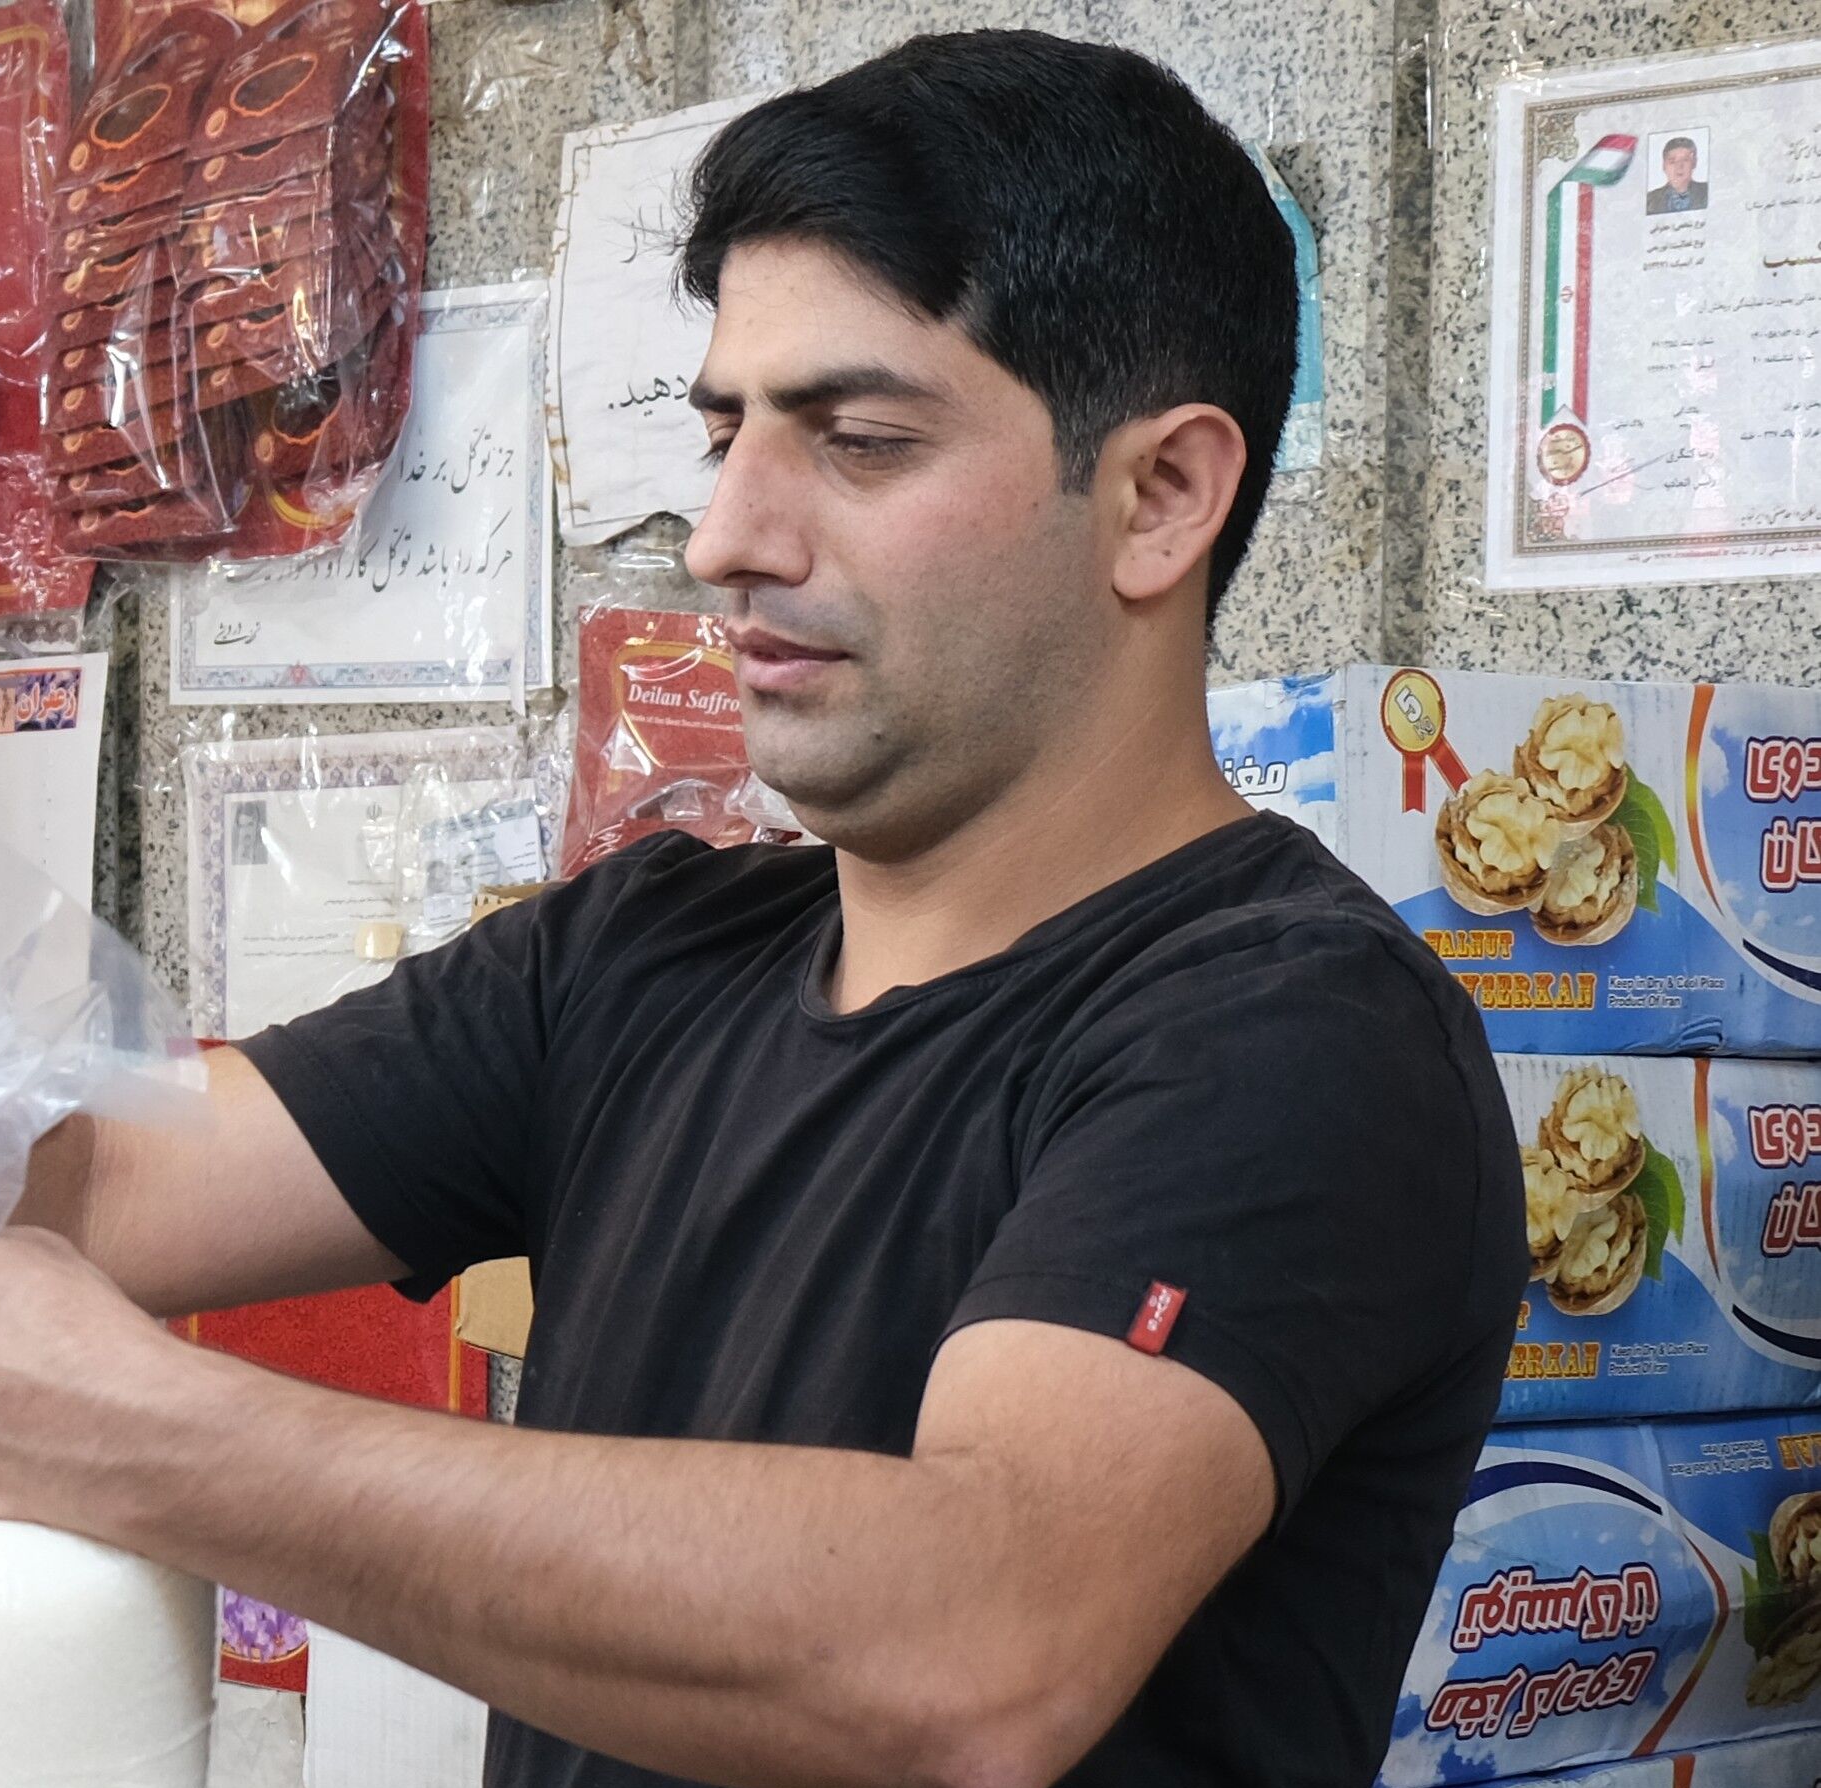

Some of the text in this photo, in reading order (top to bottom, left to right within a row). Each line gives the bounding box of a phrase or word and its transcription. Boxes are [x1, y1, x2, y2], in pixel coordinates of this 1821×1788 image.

[15, 682, 79, 722] زعفران
[628, 683, 740, 716] Deilan Saffro
[1393, 683, 1423, 724] 5
[1456, 971, 1598, 1013] YSERKAN
[1607, 993, 1683, 1010] Product Of Iran
[1608, 976, 1633, 993] Keep
[1635, 977, 1645, 990] in
[1647, 976, 1667, 994] Dry
[1676, 976, 1699, 992] Cool
[1700, 976, 1727, 992] Place
[1608, 1360, 1641, 1376] Product
[1610, 1343, 1632, 1358] Keep
[1642, 1344, 1658, 1359] Dry
[1667, 1342, 1686, 1357] Cool
[1687, 1343, 1711, 1357] Place
[1449, 1562, 1662, 1655] تویسرکان
[1424, 1646, 1659, 1741] مغز گردوی
